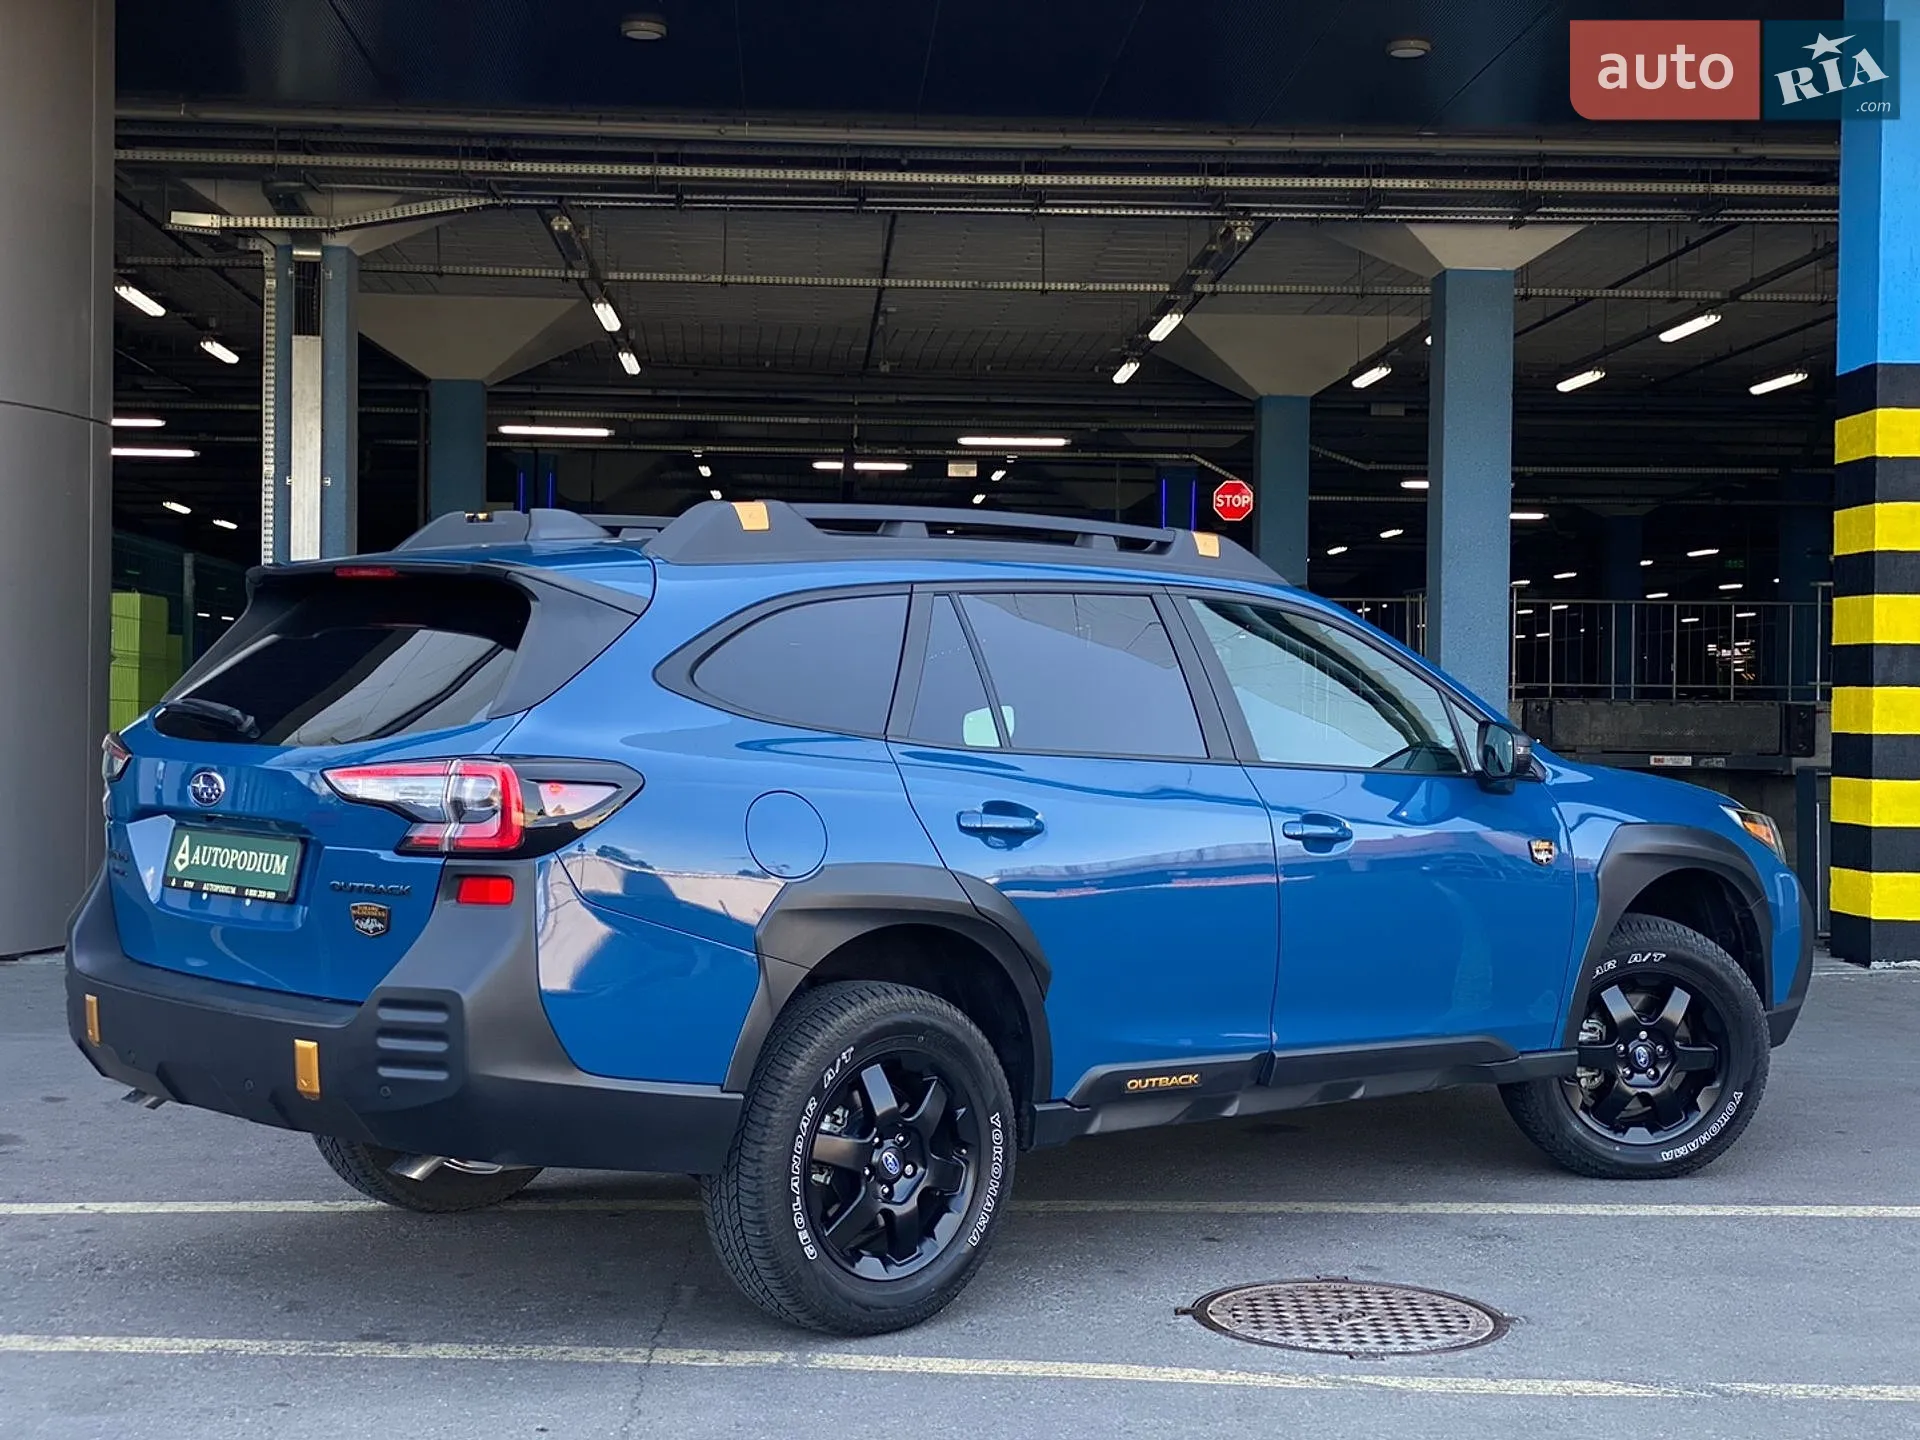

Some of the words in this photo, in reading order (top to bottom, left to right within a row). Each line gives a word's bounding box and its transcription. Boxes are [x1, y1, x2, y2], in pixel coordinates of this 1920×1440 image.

[1216, 494, 1251, 508] STOP
[190, 844, 289, 876] AUTOPODIUM
[1627, 952, 1667, 964] A/T
[1126, 1073, 1199, 1091] OUTBACK
[1661, 1091, 1744, 1161] YOKOHAMA
[790, 1096, 818, 1260] GEOLANDAR
[823, 1045, 855, 1089] A/T
[966, 1112, 1004, 1248] YOKOHAMA
